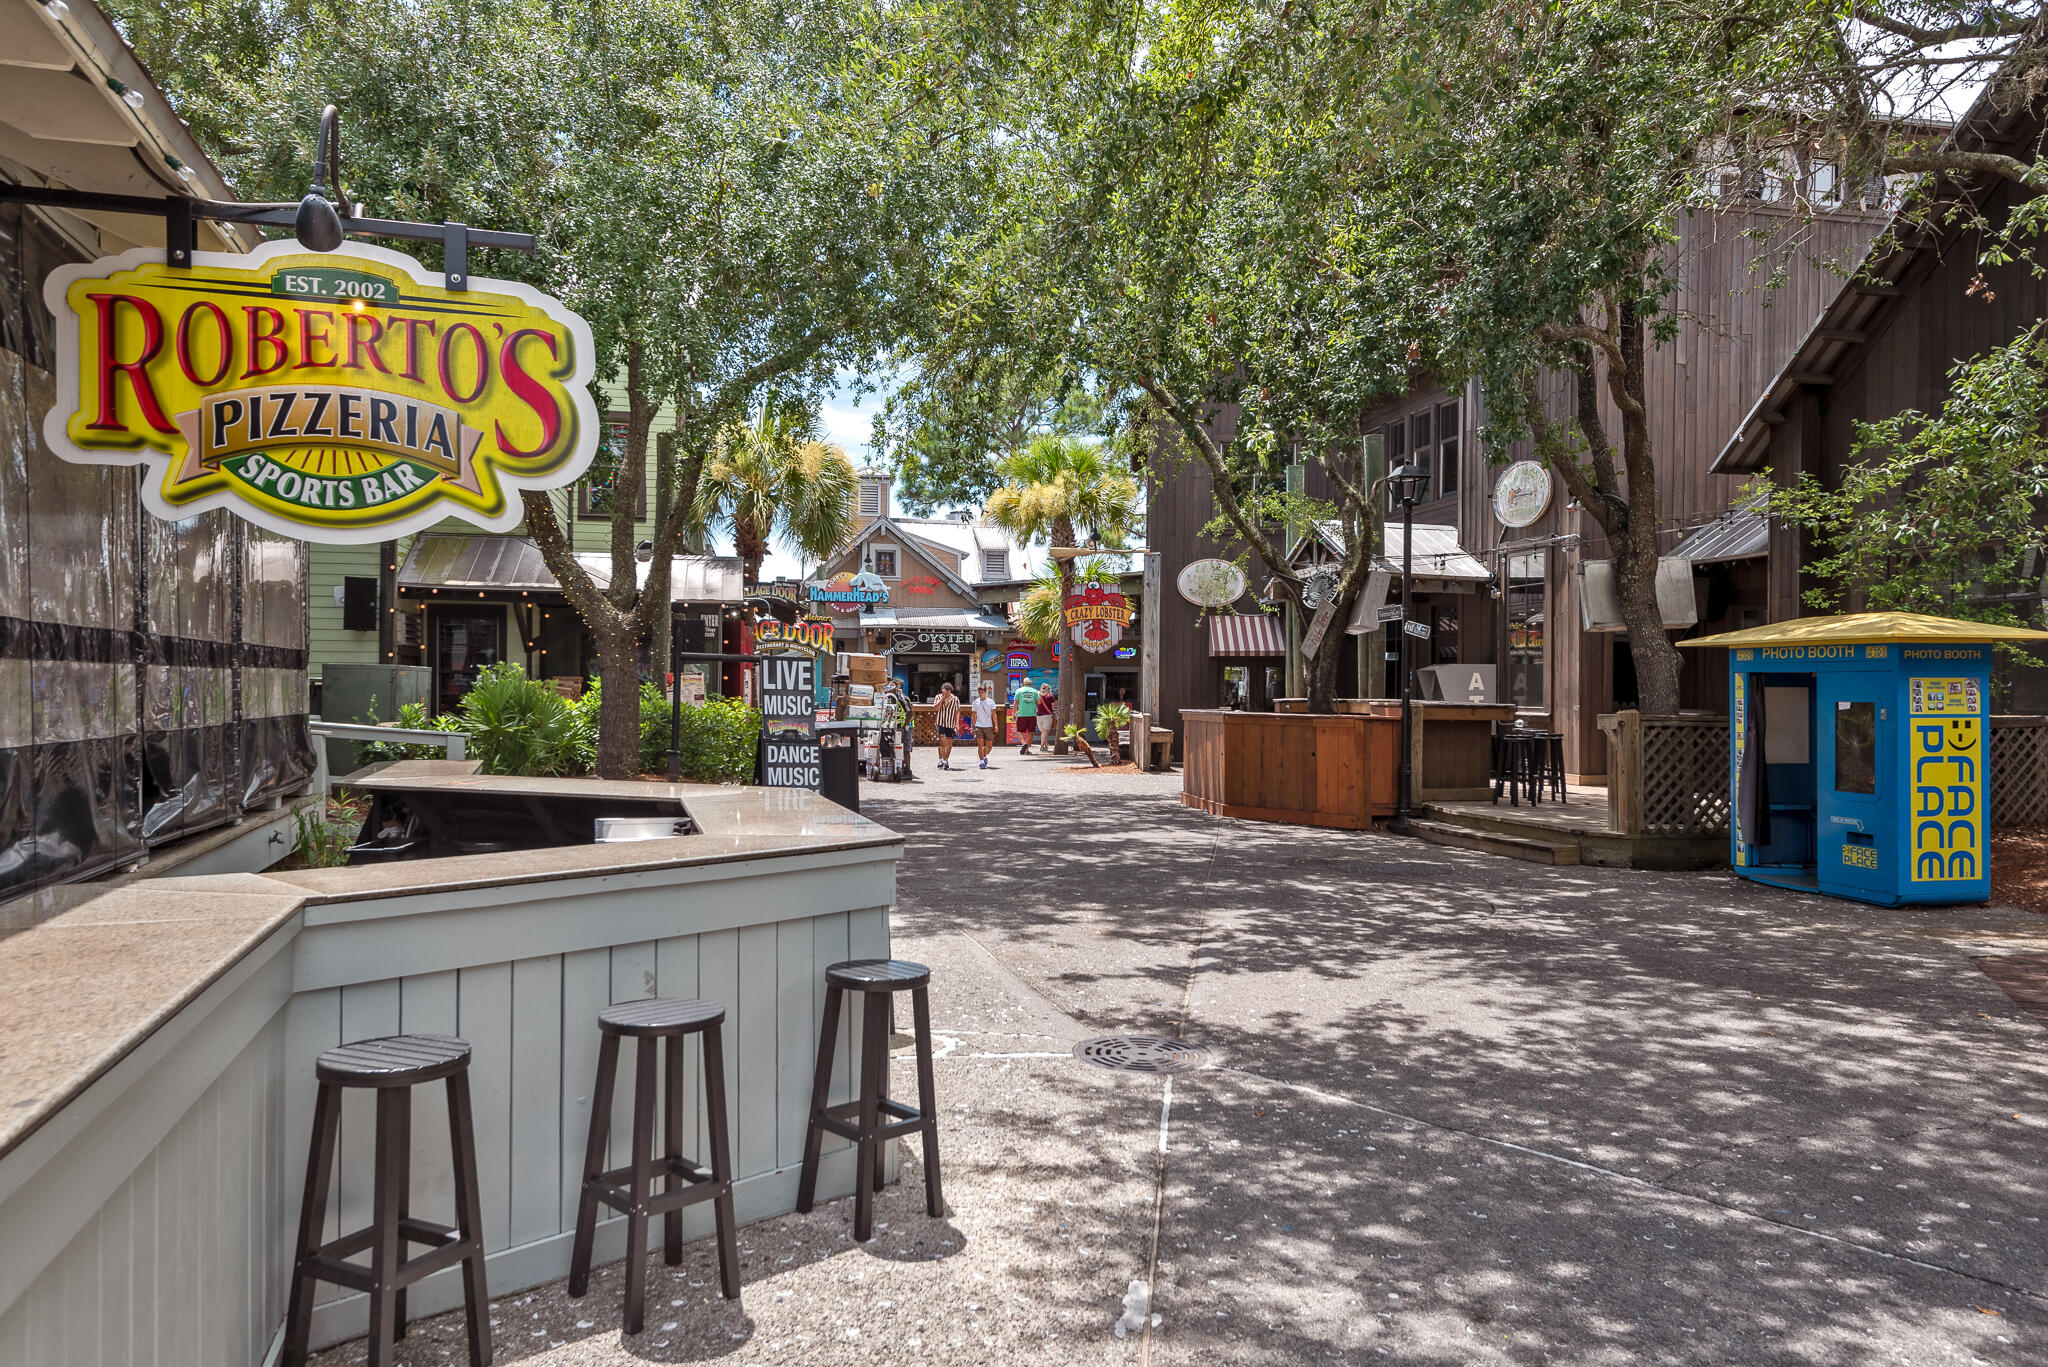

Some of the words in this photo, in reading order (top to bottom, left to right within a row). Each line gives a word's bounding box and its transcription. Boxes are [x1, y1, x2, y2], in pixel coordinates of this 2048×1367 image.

[285, 274, 327, 295] EST.
[333, 279, 385, 299] 2002
[86, 293, 561, 459] ROBERTO'S
[213, 391, 456, 461] PIZZERIA
[238, 454, 354, 507] SPORTS
[361, 462, 424, 505] BAR
[771, 586, 798, 604] DOOR
[830, 603, 840, 611] BAR
[1070, 606, 1093, 620] CRAZY
[1095, 606, 1126, 621] LOBSTER
[783, 621, 836, 656] DOOR
[917, 633, 976, 643] OYSTER
[931, 643, 961, 653] BAR
[1762, 646, 1804, 659] PHOTO
[1807, 645, 1855, 658] BOOTH
[1904, 649, 1942, 659] PHOTO
[1943, 649, 1981, 659] BOOTH
[762, 659, 812, 691] LIVE
[763, 694, 812, 716] MUSIC
[767, 745, 820, 764] DANCE
[767, 767, 820, 786] MUSIC
[1916, 725, 1945, 879] PLACE
[1947, 755, 1975, 878] FACE
[1844, 854, 1878, 869] PLACE
[1850, 846, 1878, 859] FACE
